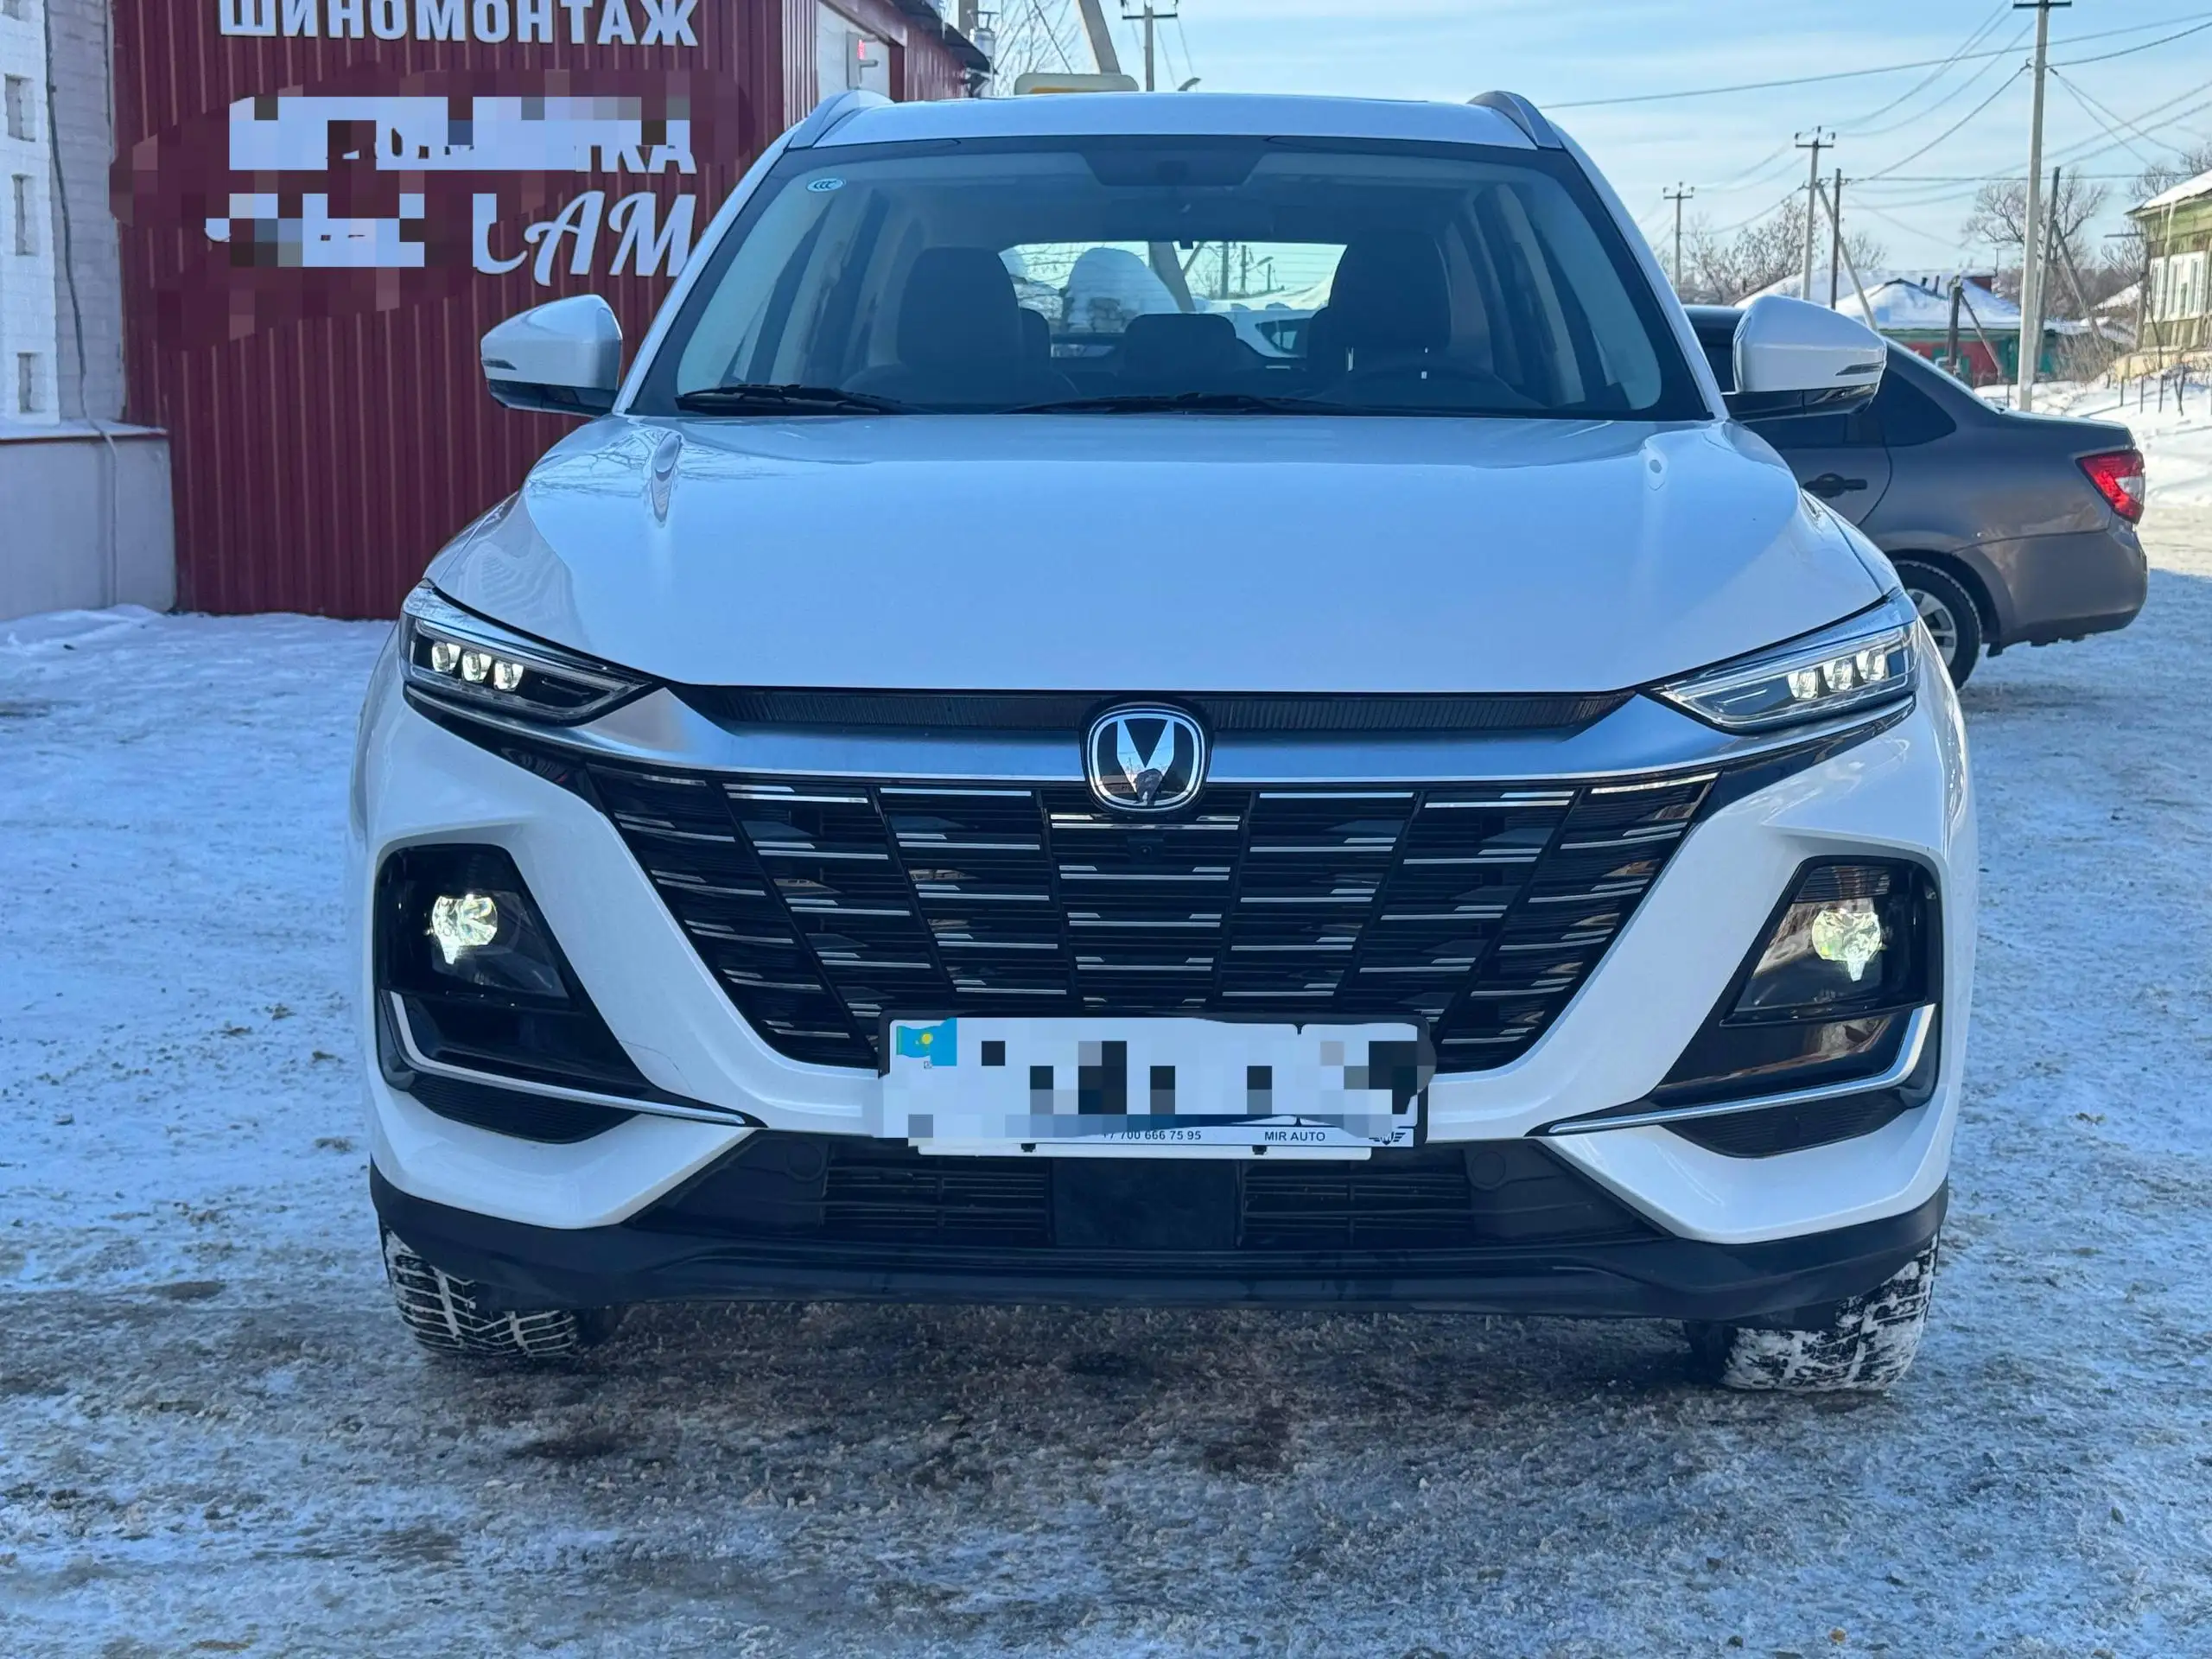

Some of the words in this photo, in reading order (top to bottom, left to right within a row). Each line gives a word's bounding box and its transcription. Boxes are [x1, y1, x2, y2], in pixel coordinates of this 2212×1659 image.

[219, 0, 698, 47] ШИНОМОНТАЖ
[1144, 1130, 1166, 1141] 666
[1169, 1130, 1185, 1141] 75
[1186, 1130, 1202, 1141] 95
[1264, 1131, 1287, 1141] MIR
[1289, 1131, 1326, 1141] AUTO
